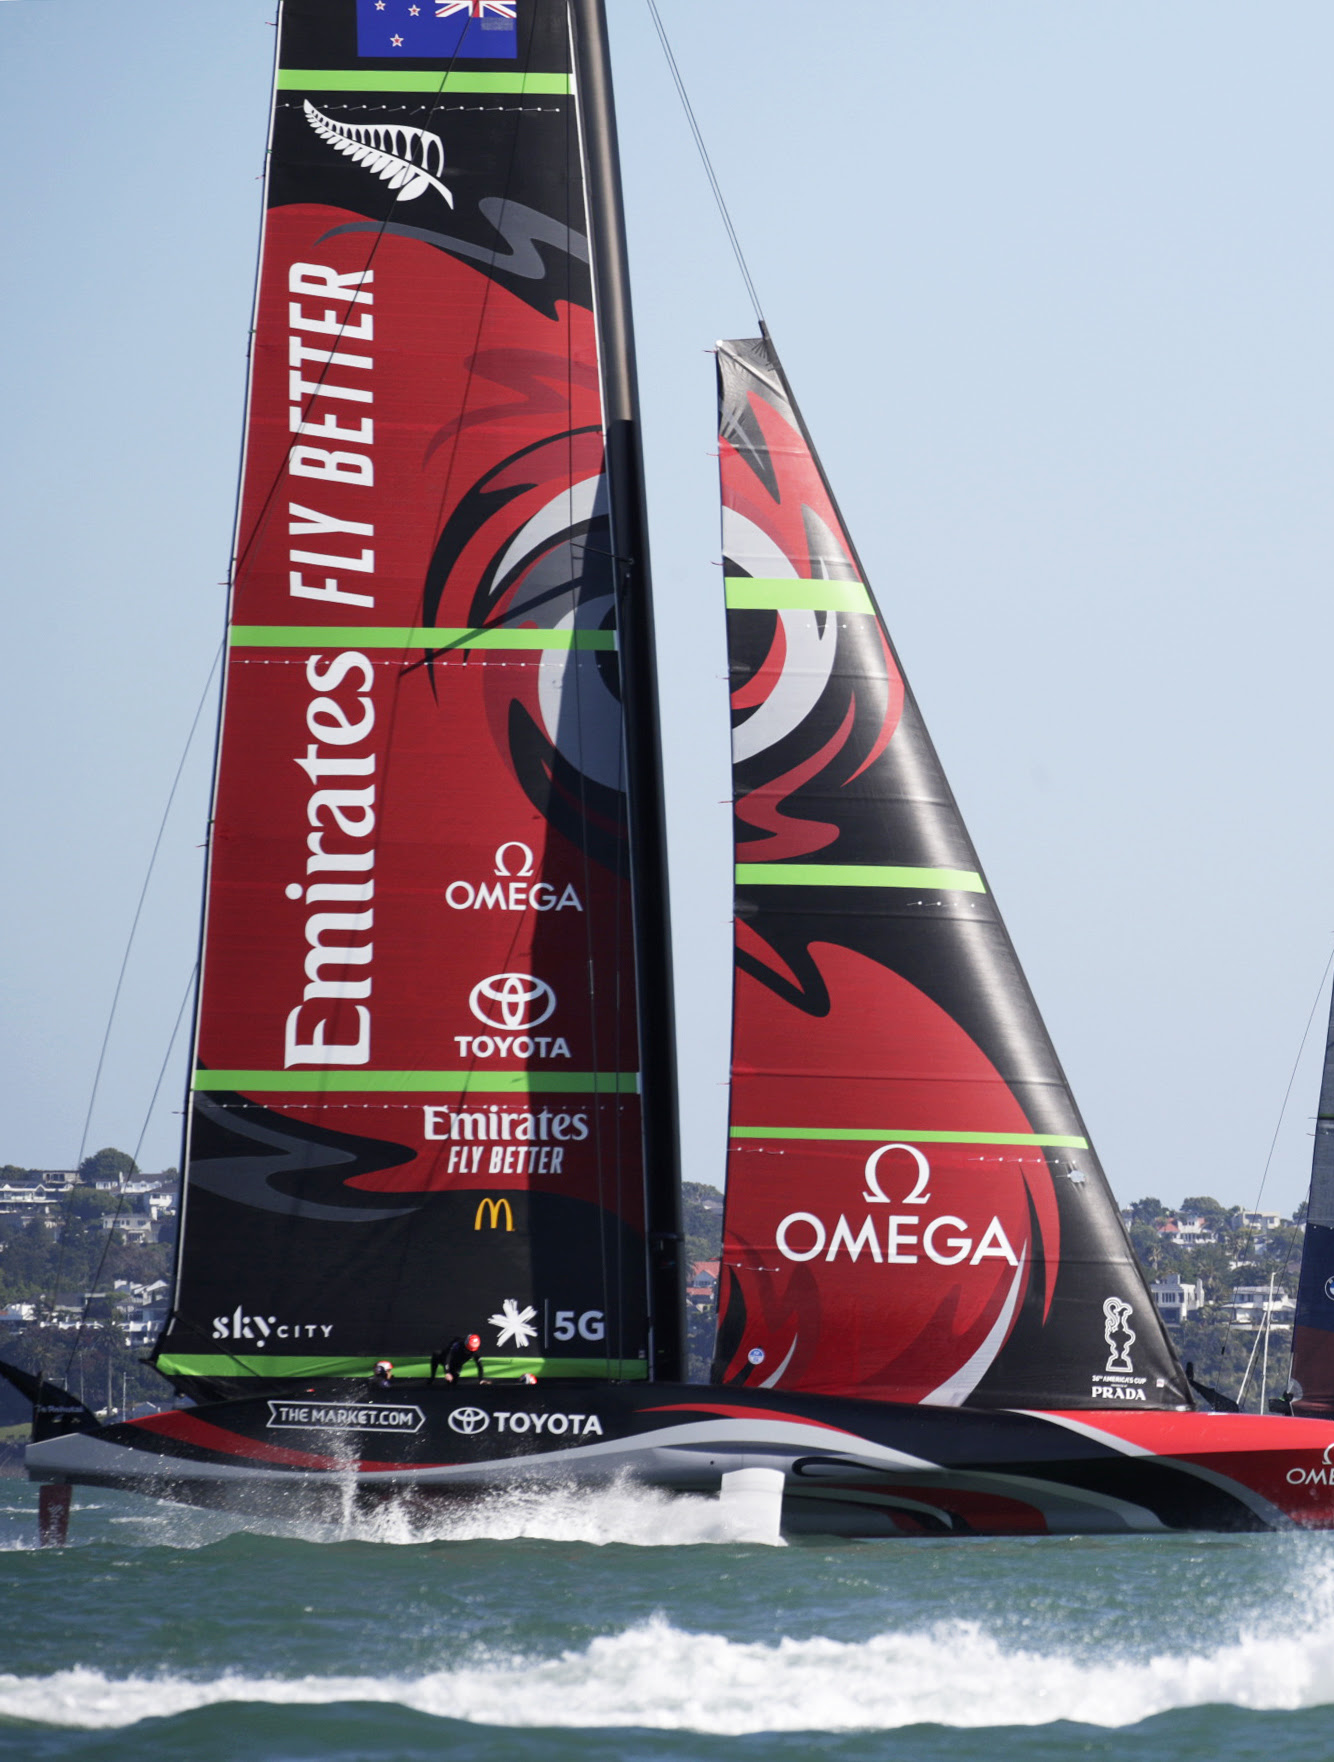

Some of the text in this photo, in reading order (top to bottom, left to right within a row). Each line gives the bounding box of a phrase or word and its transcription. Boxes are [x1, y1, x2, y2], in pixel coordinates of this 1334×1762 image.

[289, 262, 374, 608] FLY BETTER
[284, 651, 375, 1069] Emirates
[446, 881, 583, 911] OMEGA
[454, 1036, 572, 1058] TOYOTA
[423, 1105, 589, 1141] Emirates
[447, 1146, 564, 1174] FLY BETTER
[776, 1212, 1019, 1266] OMEGA
[553, 1311, 605, 1341] 5G
[1091, 1386, 1147, 1400] PRADA
[493, 1411, 603, 1435] TOYOTA
